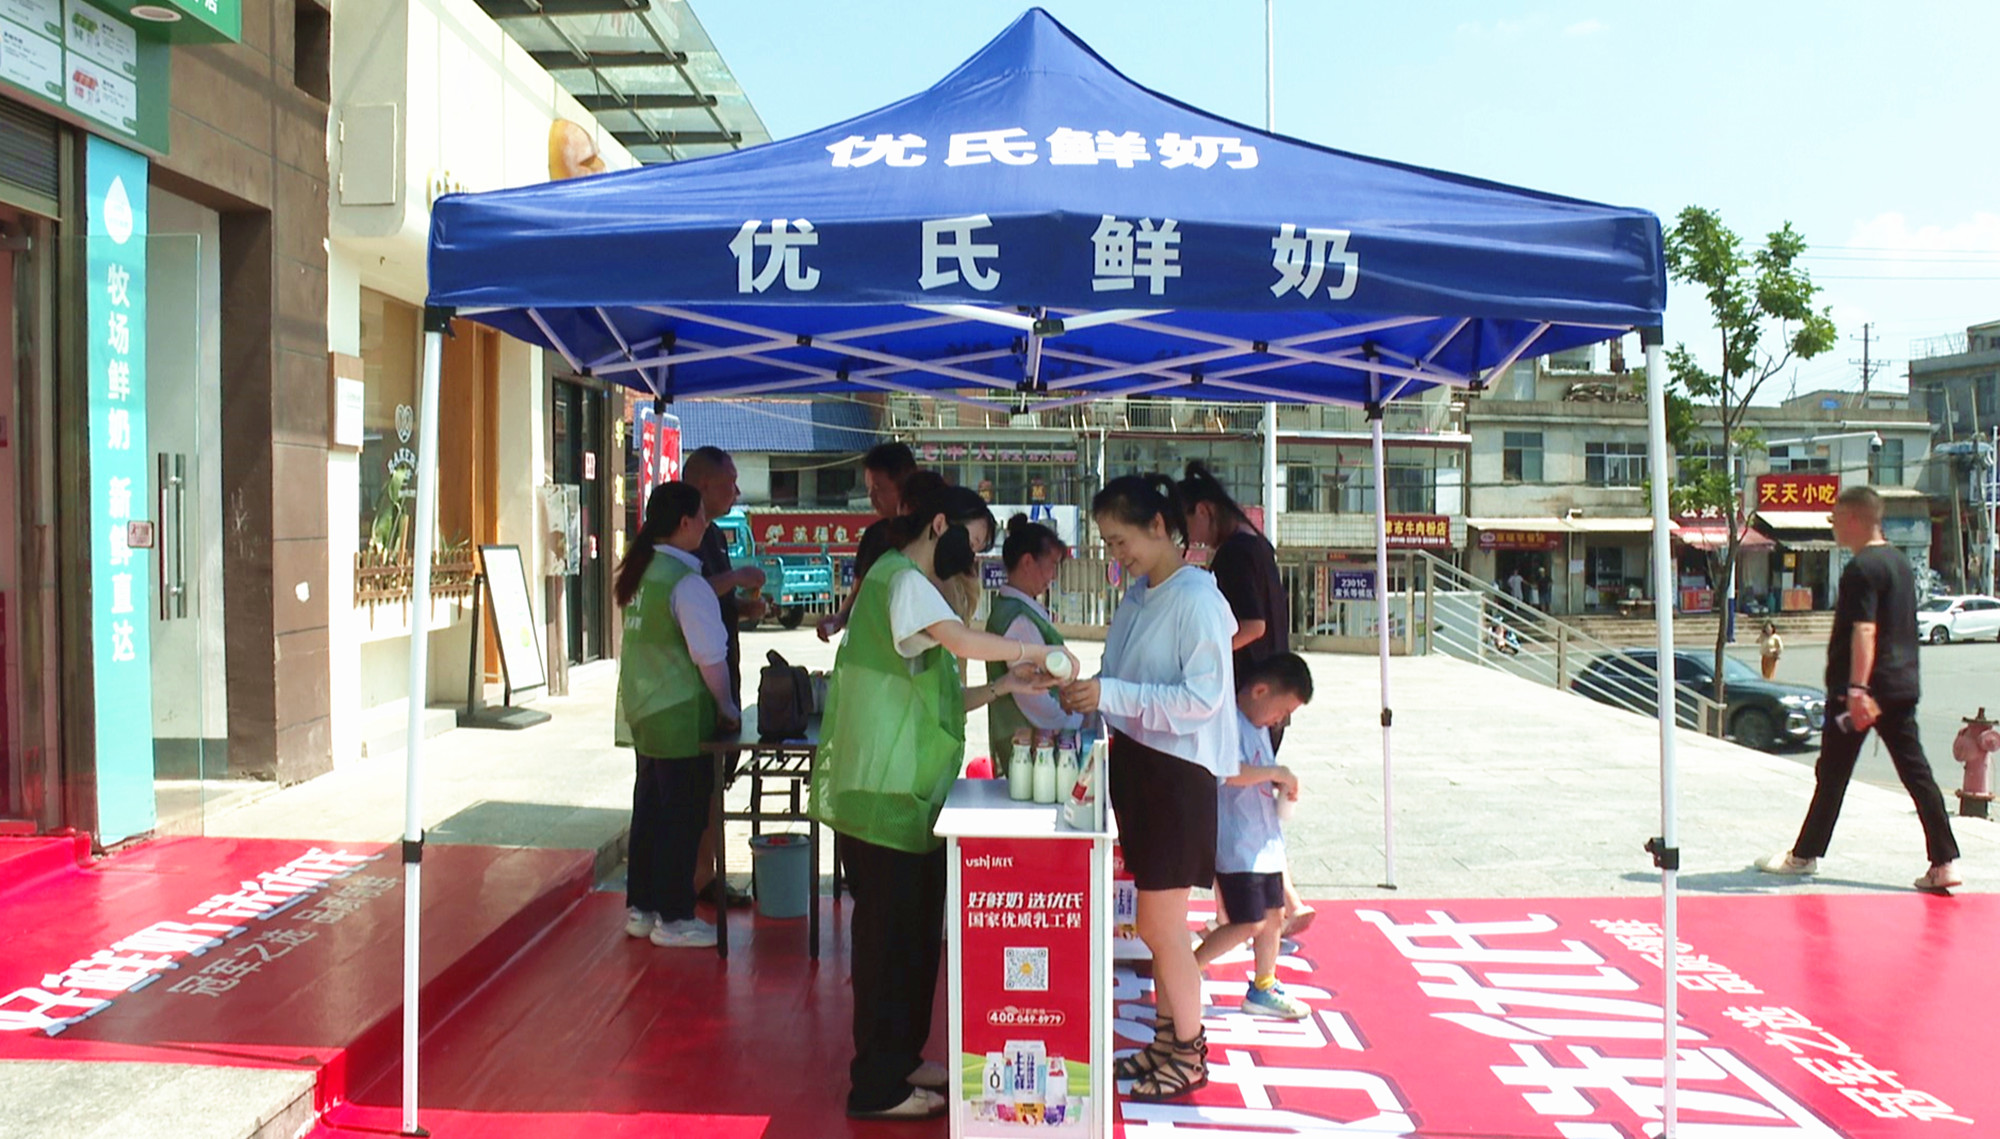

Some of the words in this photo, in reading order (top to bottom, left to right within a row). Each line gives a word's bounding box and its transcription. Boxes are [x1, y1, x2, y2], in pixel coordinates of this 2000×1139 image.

[826, 127, 1259, 170] 优氏鲜奶
[728, 214, 1360, 300] 优氏鲜奶
[107, 263, 130, 450] 牧场鲜奶
[1761, 483, 1837, 505] 天天小吃
[109, 475, 135, 662] 新鲜直达
[967, 891, 1024, 909] 好鲜奶
[1027, 891, 1084, 909] 选优氏
[968, 912, 1082, 929] 国家优质乳工程
[0, 921, 248, 1037] 好鲜奶
[166, 928, 319, 997] 冠军之选
[1722, 1005, 1975, 1125] 冠军之选
